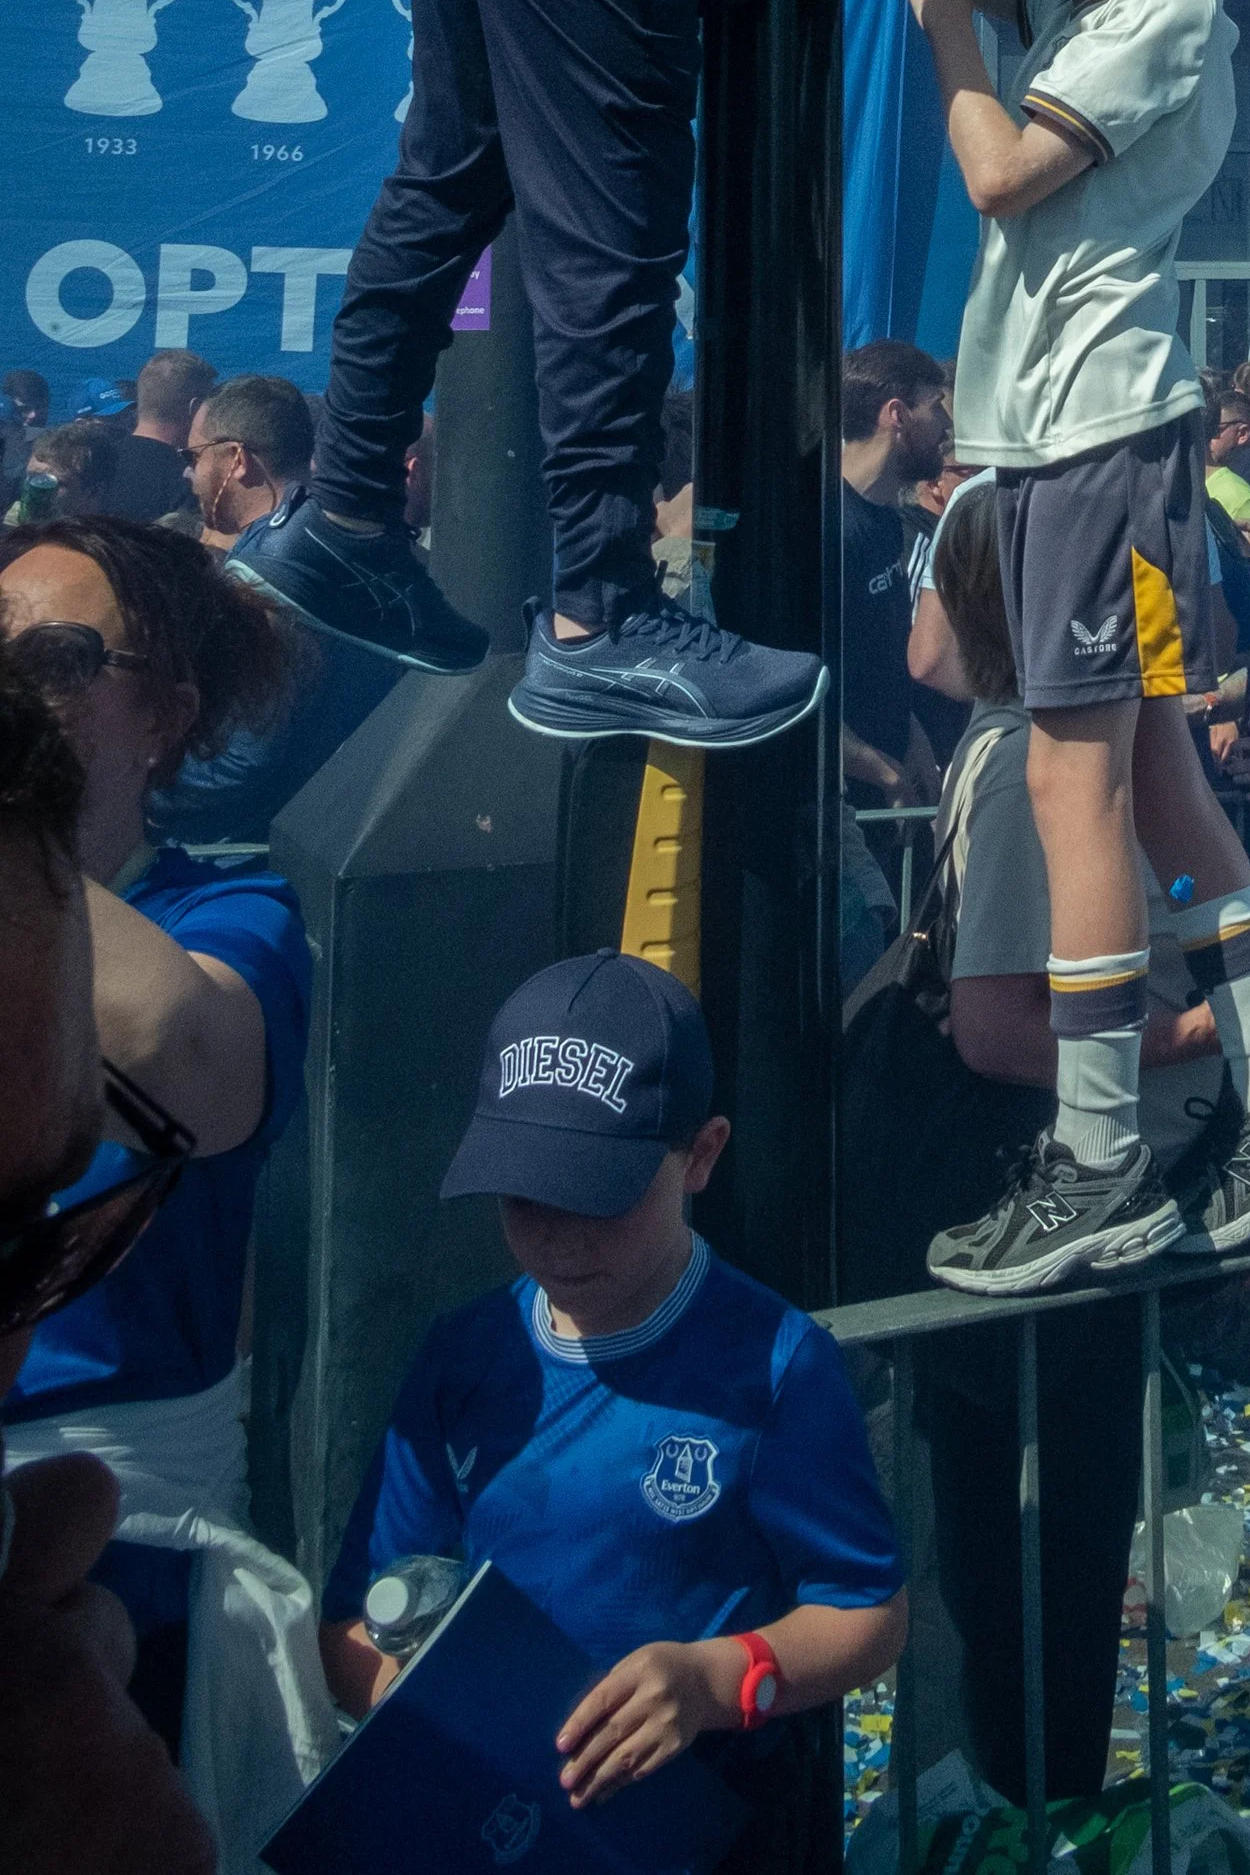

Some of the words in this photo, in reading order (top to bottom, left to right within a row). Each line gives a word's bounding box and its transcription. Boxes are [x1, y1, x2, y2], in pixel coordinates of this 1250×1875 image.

[85, 137, 138, 156] 1933
[251, 144, 304, 163] 1966
[26, 239, 353, 353] OPT
[455, 307, 486, 316] ephone
[499, 1036, 635, 1114] DIESEL
[661, 1478, 700, 1495] Everton
